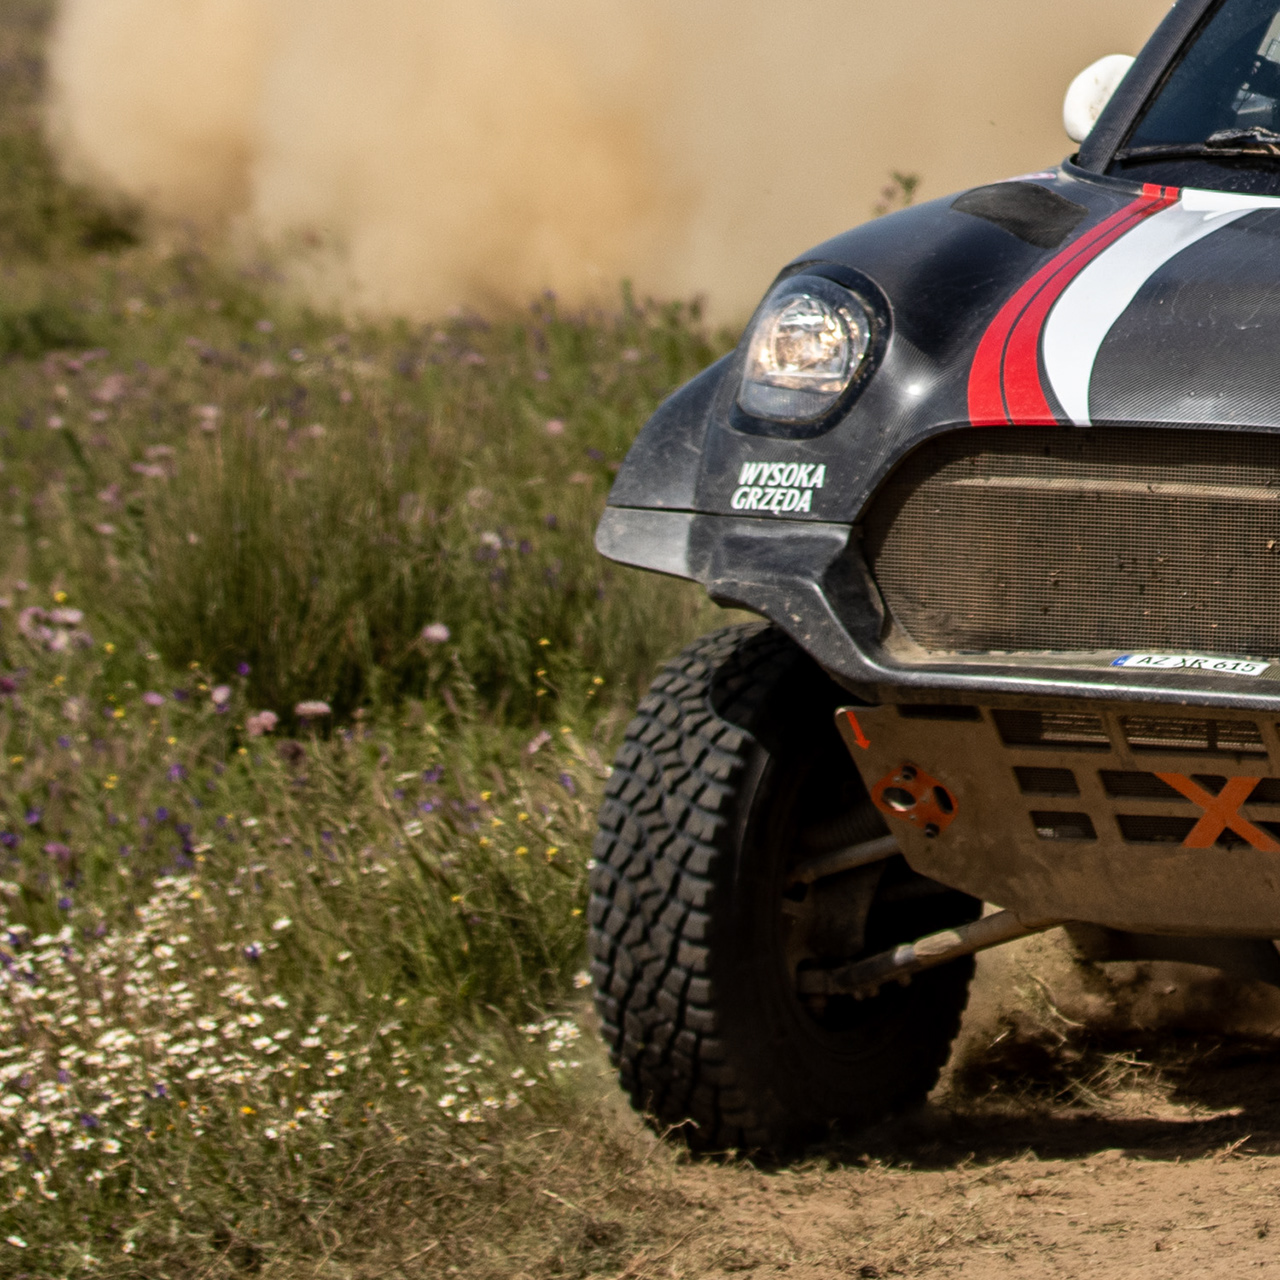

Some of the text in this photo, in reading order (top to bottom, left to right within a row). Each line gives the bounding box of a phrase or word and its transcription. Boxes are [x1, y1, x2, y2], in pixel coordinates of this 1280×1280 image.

[738, 461, 826, 488] WYSOKA
[731, 486, 813, 516] GRZĘDA
[1136, 656, 1256, 672] AZ XR 615
